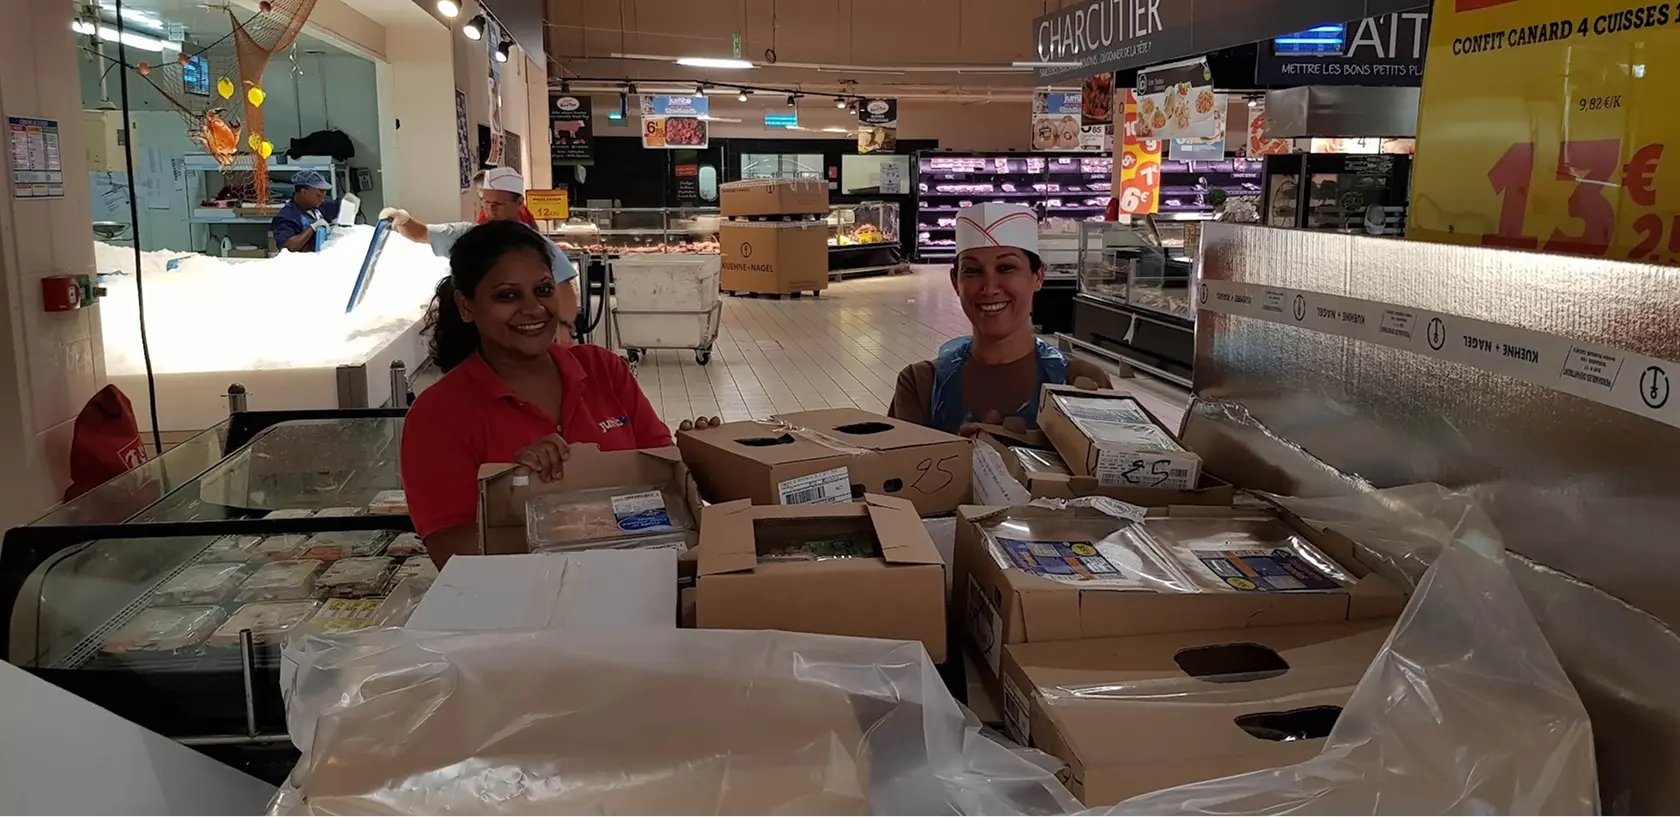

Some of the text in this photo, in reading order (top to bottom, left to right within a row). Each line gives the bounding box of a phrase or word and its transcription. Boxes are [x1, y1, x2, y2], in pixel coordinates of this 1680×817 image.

[1038, 0, 1163, 62] CHARCUTIER
[1452, 31, 1505, 56] CONFIT
[1508, 20, 1572, 47] CANARD
[1576, 17, 1589, 37] 4
[1593, 3, 1670, 36] CUISSES
[1281, 63, 1320, 75] METTRE
[1322, 64, 1341, 75] LES
[1343, 64, 1371, 75] BONS
[1373, 65, 1407, 75] PETITS
[1317, 306, 1336, 318] NAGEL
[1343, 312, 1366, 324] KUEHNE
[1463, 335, 1492, 352] NAGEL
[1503, 345, 1539, 363] KUEHNE
